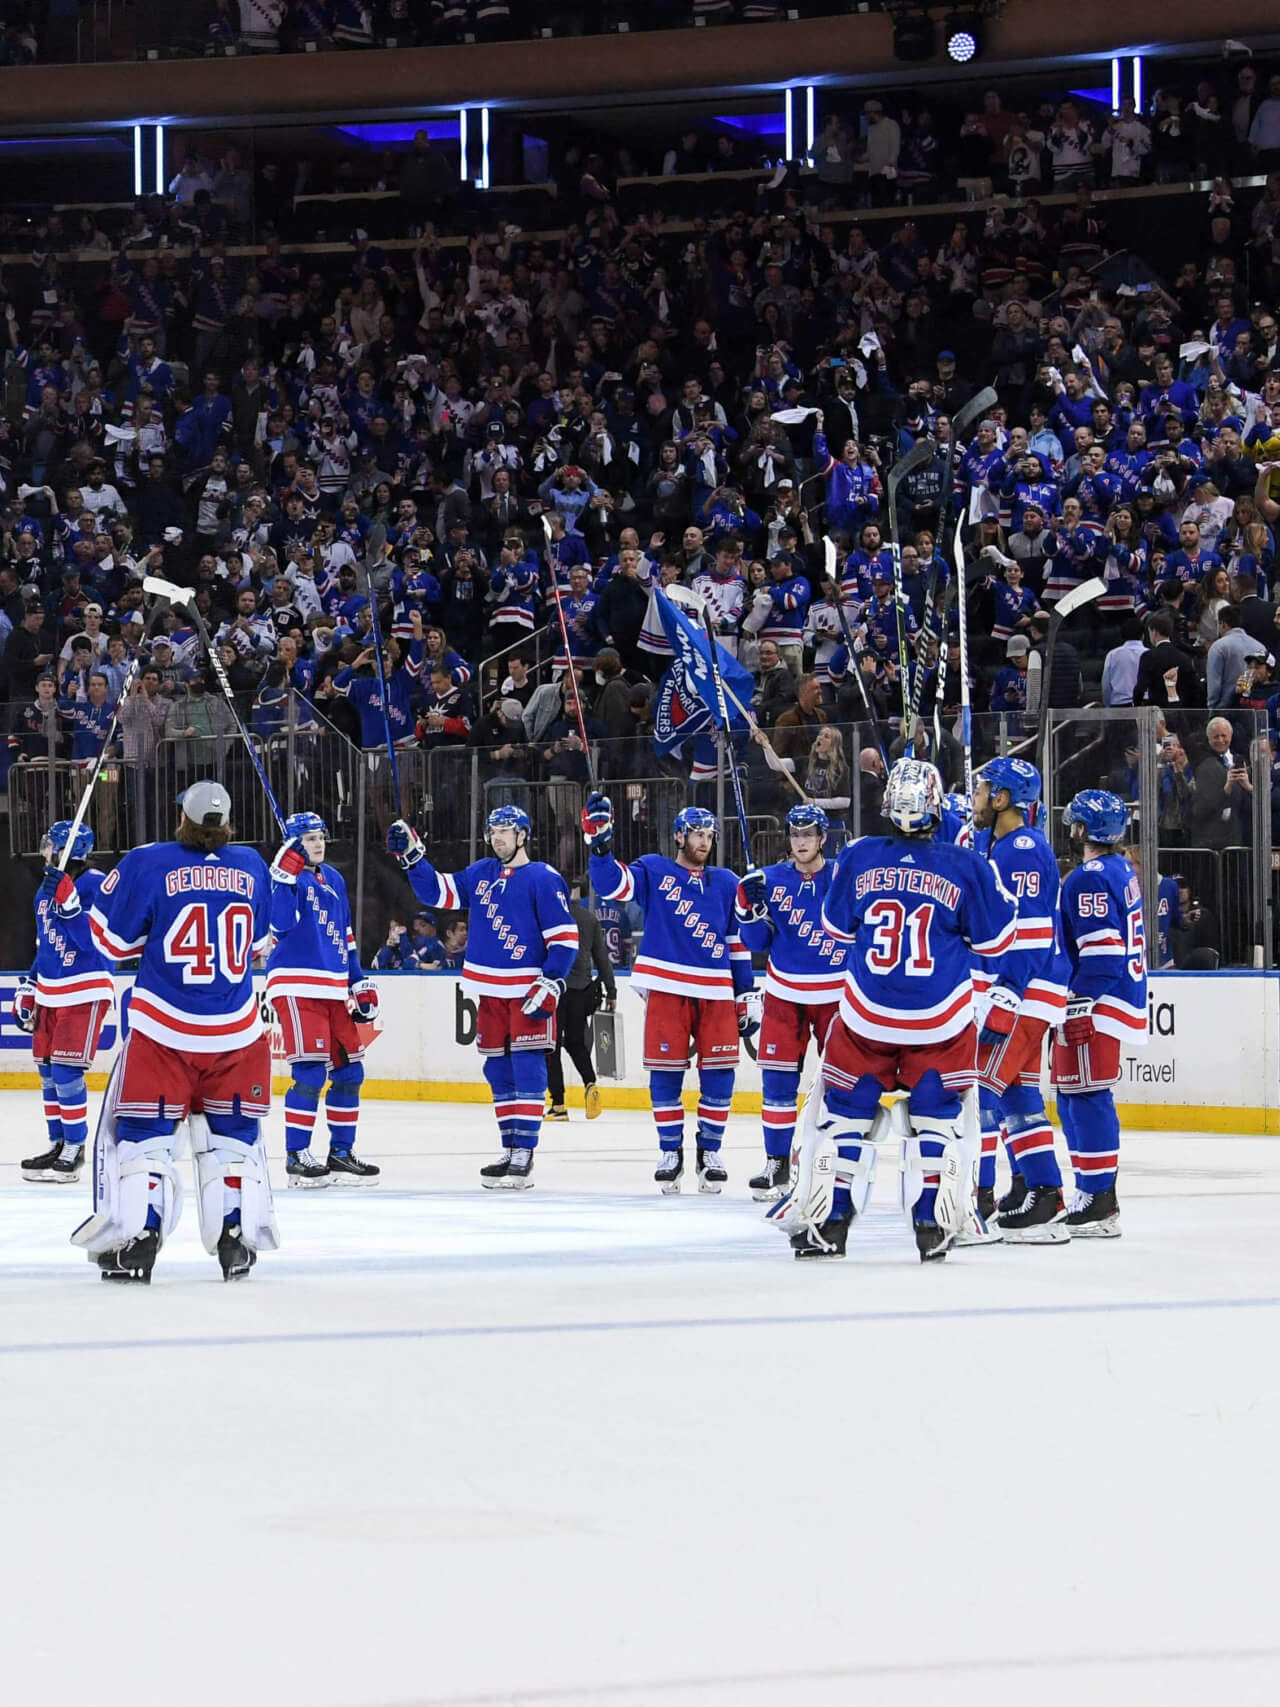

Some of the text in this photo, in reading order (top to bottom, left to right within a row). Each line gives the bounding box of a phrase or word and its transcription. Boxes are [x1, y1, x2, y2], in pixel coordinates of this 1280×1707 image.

[208, 648, 234, 698] BAUER
[936, 642, 948, 700] CCM
[659, 679, 675, 733] RANGERS
[627, 785, 641, 797] 109
[165, 866, 255, 899] GEORGIEV
[856, 867, 961, 911] SHESTERKIN
[1011, 871, 1039, 897] 79
[1078, 893, 1108, 918] 55
[163, 902, 254, 984] 40
[475, 880, 527, 960] RANGERS
[659, 875, 724, 959] RANGERS
[770, 886, 846, 966] RANGERS
[864, 898, 935, 977] 31
[1127, 908, 1148, 982] 5
[1148, 991, 1175, 1036] ia
[1126, 1057, 1175, 1082] Travel
